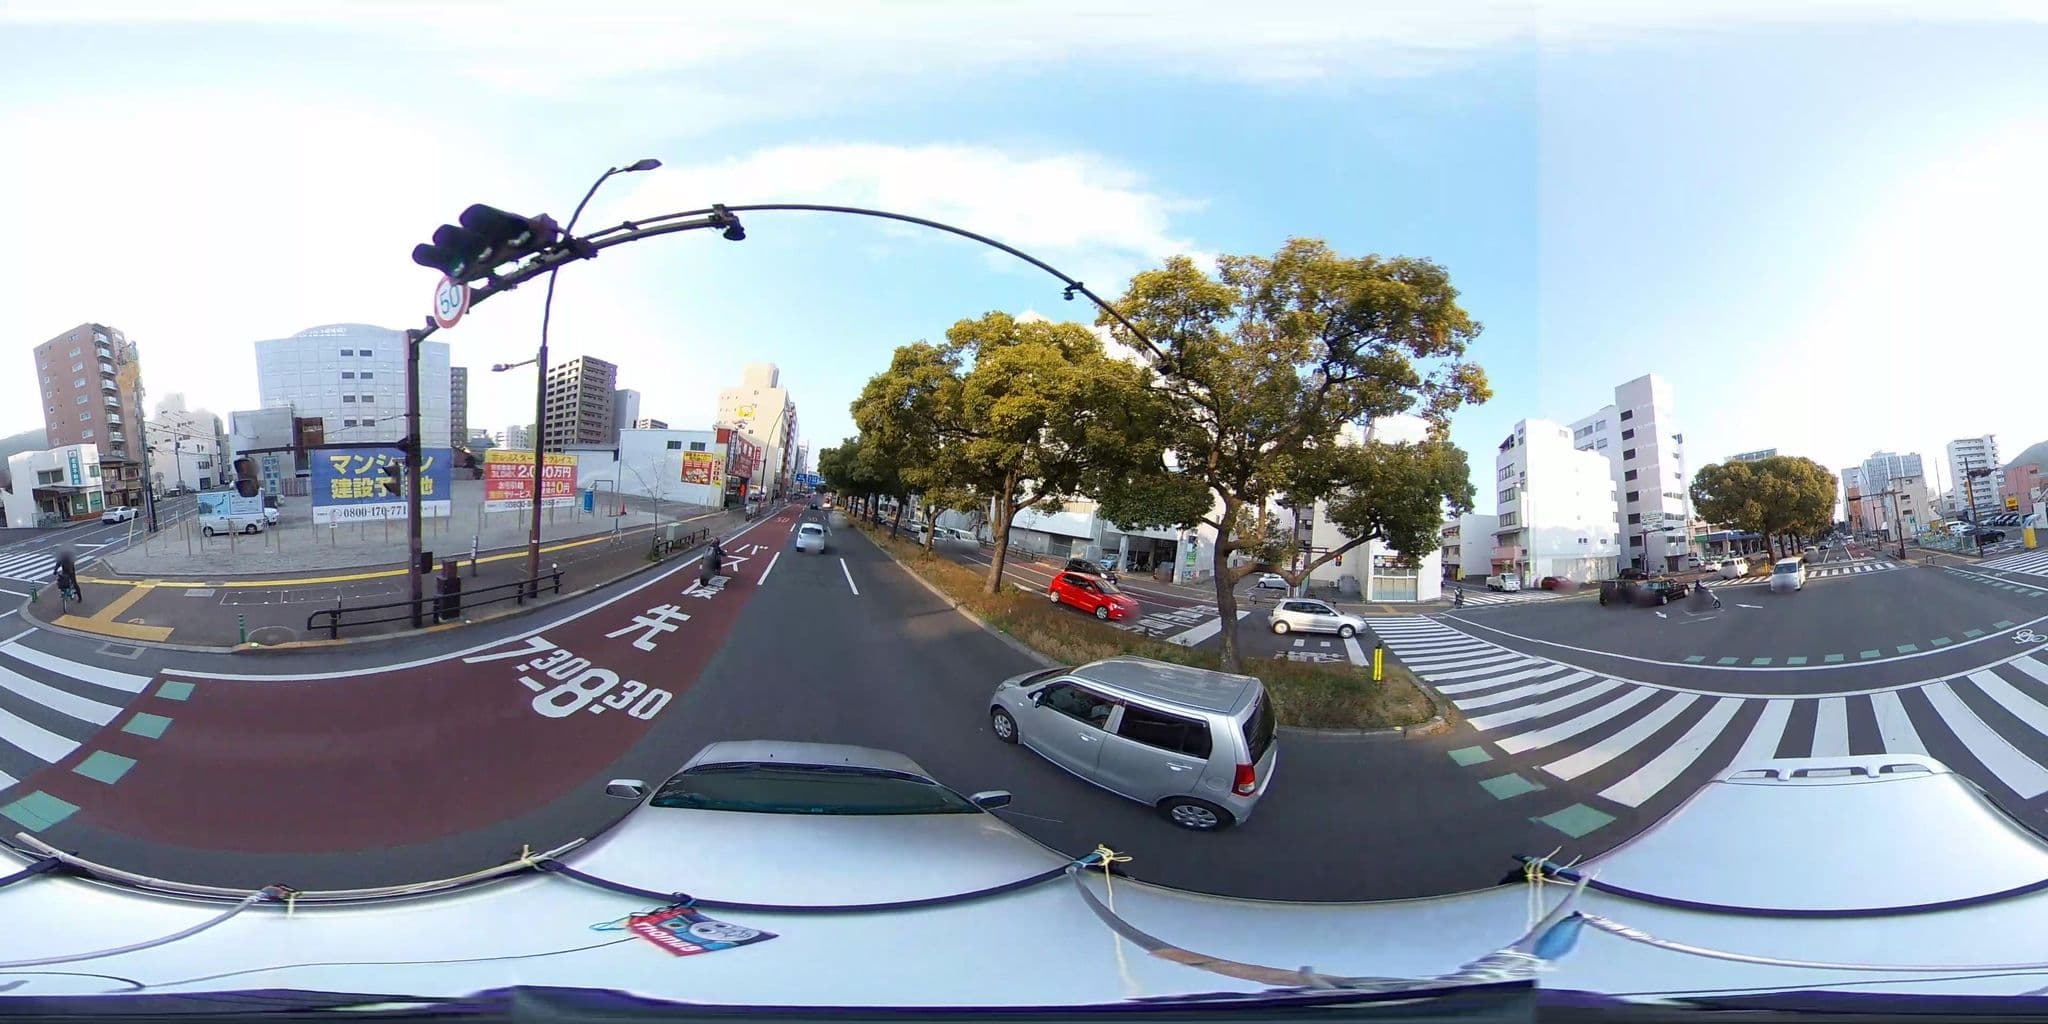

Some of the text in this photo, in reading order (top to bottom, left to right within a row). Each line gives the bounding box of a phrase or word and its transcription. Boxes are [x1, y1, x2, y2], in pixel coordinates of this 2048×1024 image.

[440, 285, 459, 314] 50
[330, 454, 434, 474] マンシン
[330, 476, 433, 499] 建設予地
[343, 505, 408, 518] 0800-170-771
